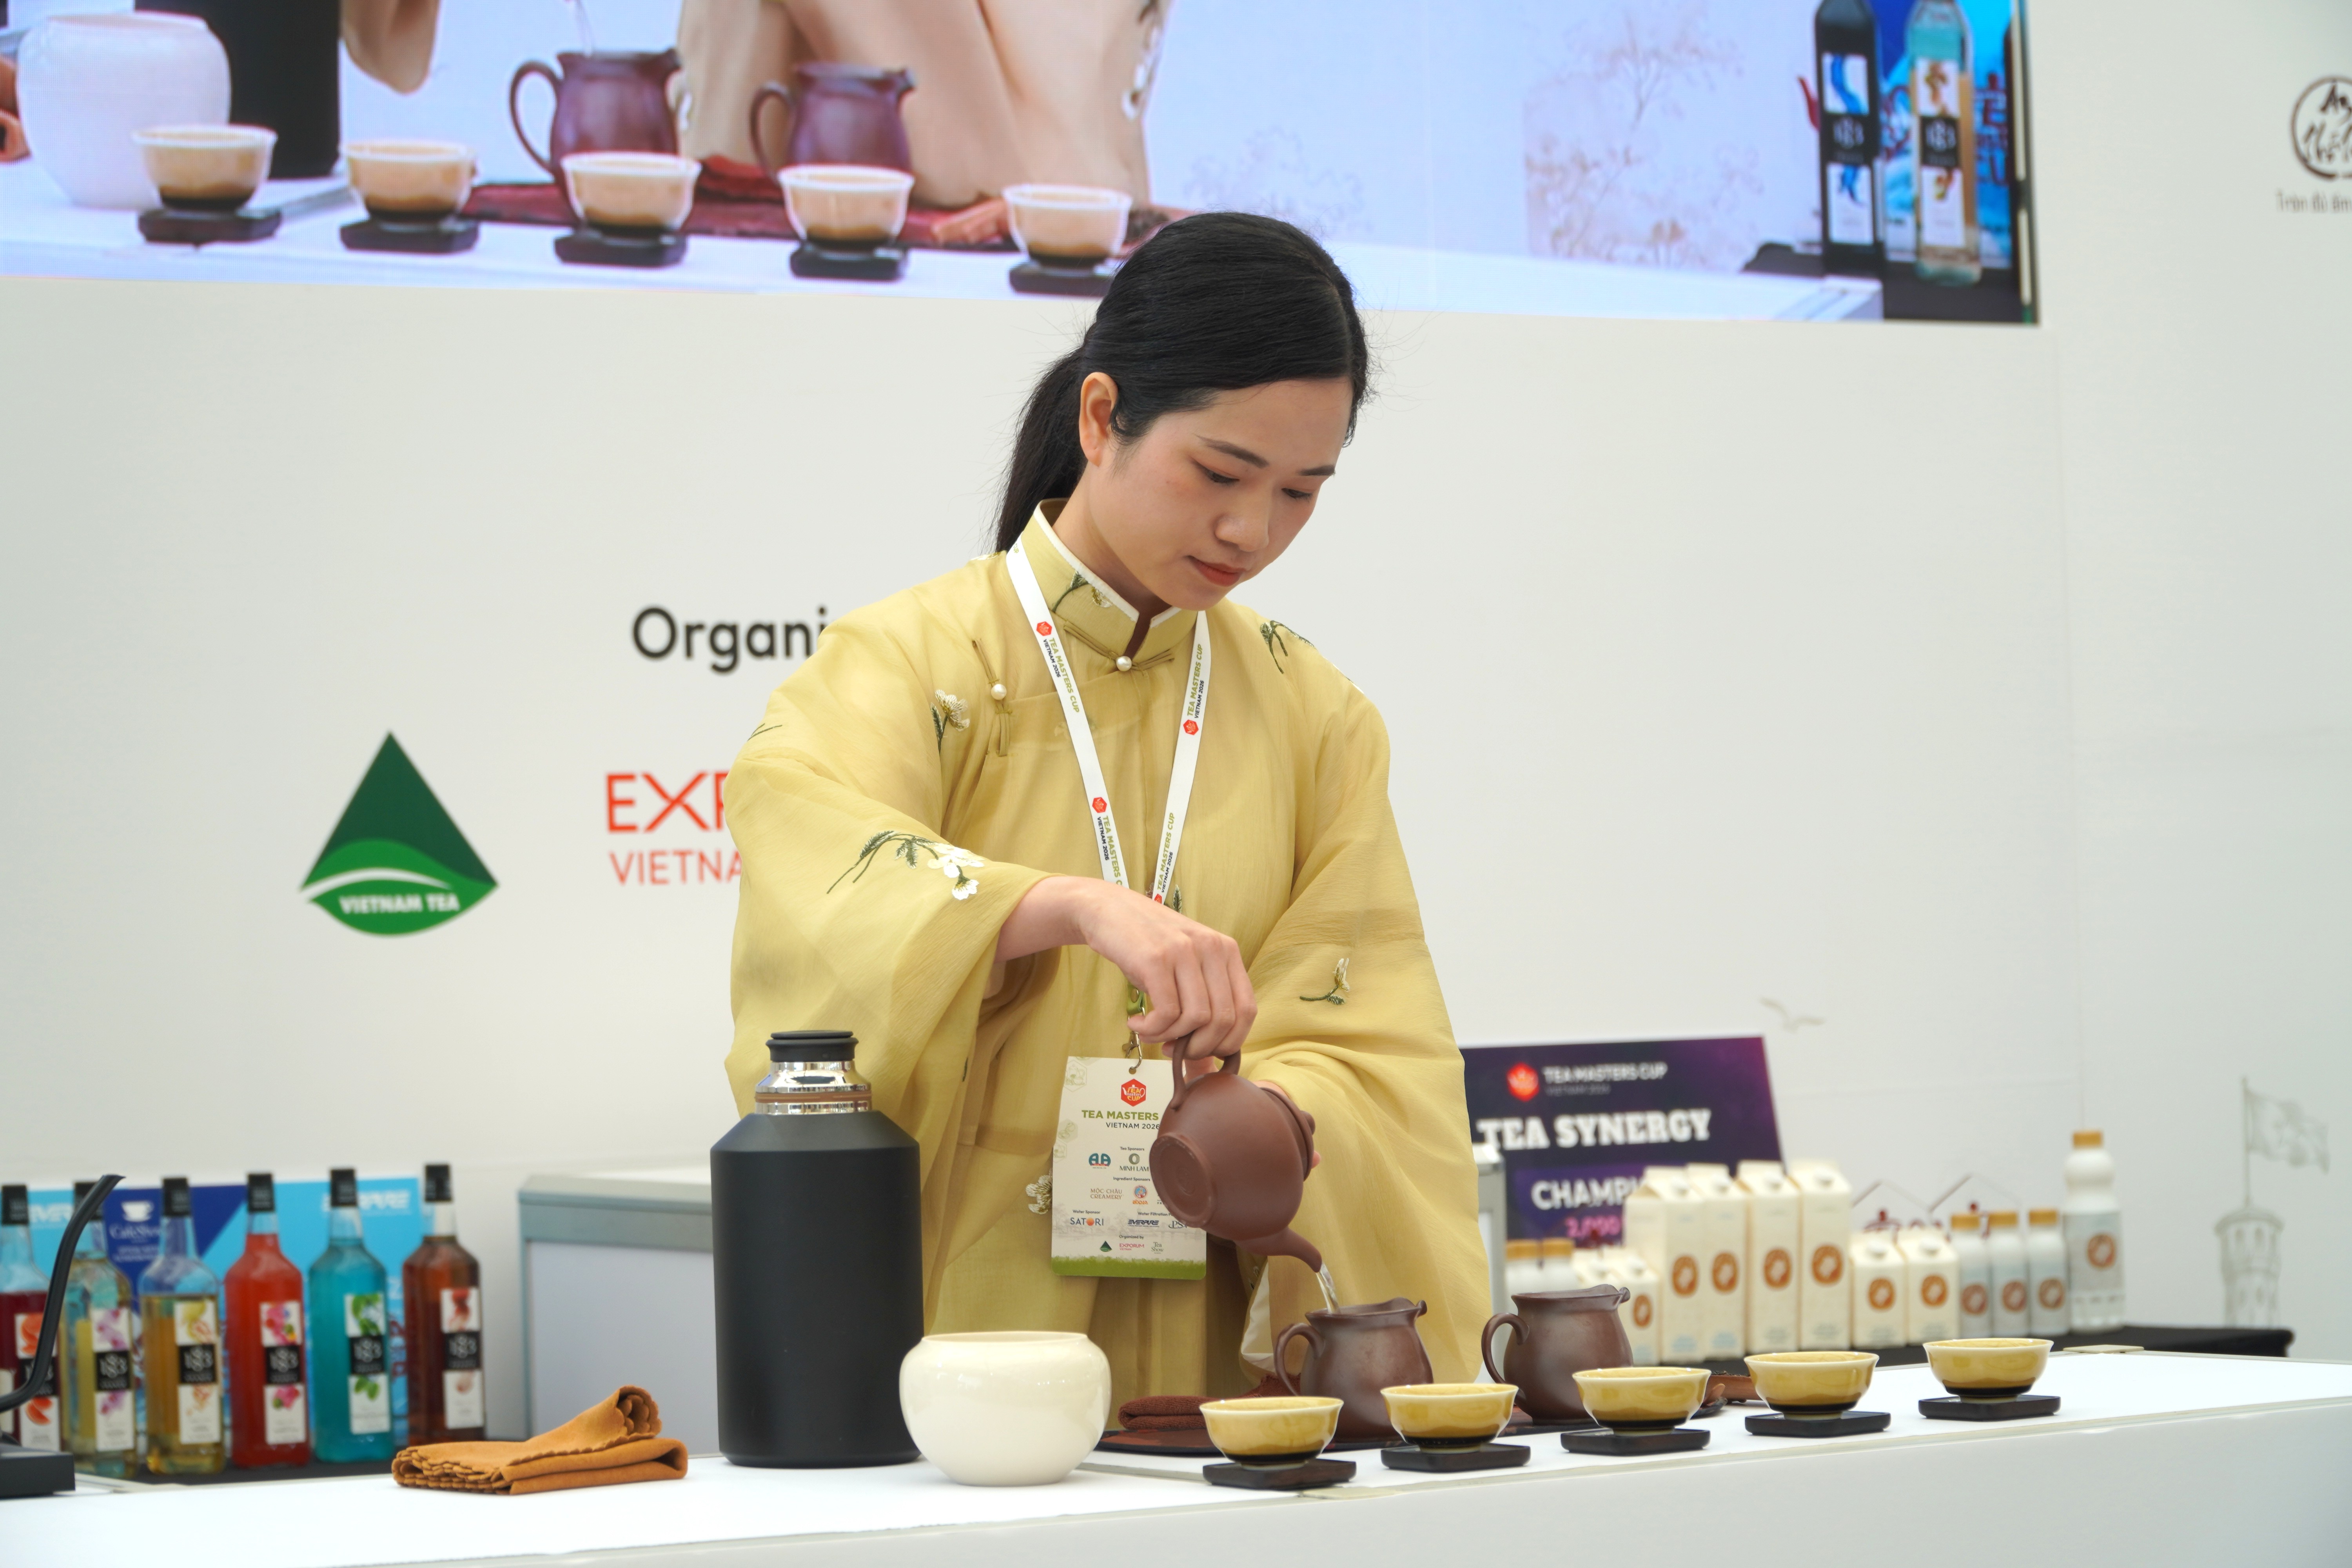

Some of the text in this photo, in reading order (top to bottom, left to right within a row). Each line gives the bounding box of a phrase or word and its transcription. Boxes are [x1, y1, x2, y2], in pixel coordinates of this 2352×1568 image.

[632, 604, 828, 675] Organi
[1043, 639, 1055, 663] VIETNAM
[1053, 664, 1061, 678] 2026
[1049, 637, 1080, 713] TEA MASTERS CUP
[1190, 661, 1201, 699] MASTERS
[1187, 701, 1195, 716] TEA
[1097, 817, 1106, 844] VIETNAM
[609, 849, 742, 886] VIETNA
[1107, 836, 1121, 878] MASTERS
[1160, 831, 1171, 872] MASTERS
[1161, 867, 1170, 893] VIETNAM
[338, 893, 461, 914] VIETNAM TEA
[1542, 1065, 1571, 1084] TEA
[1572, 1063, 1638, 1082] MASTERS
[1639, 1061, 1668, 1080] CUP
[1082, 1110, 1159, 1120] TEA MASTERS
[1476, 1108, 1711, 1151] TEA SYNERGY
[1531, 1176, 1641, 1210] CHAMPI
[1070, 1217, 1103, 1226] SATORI
